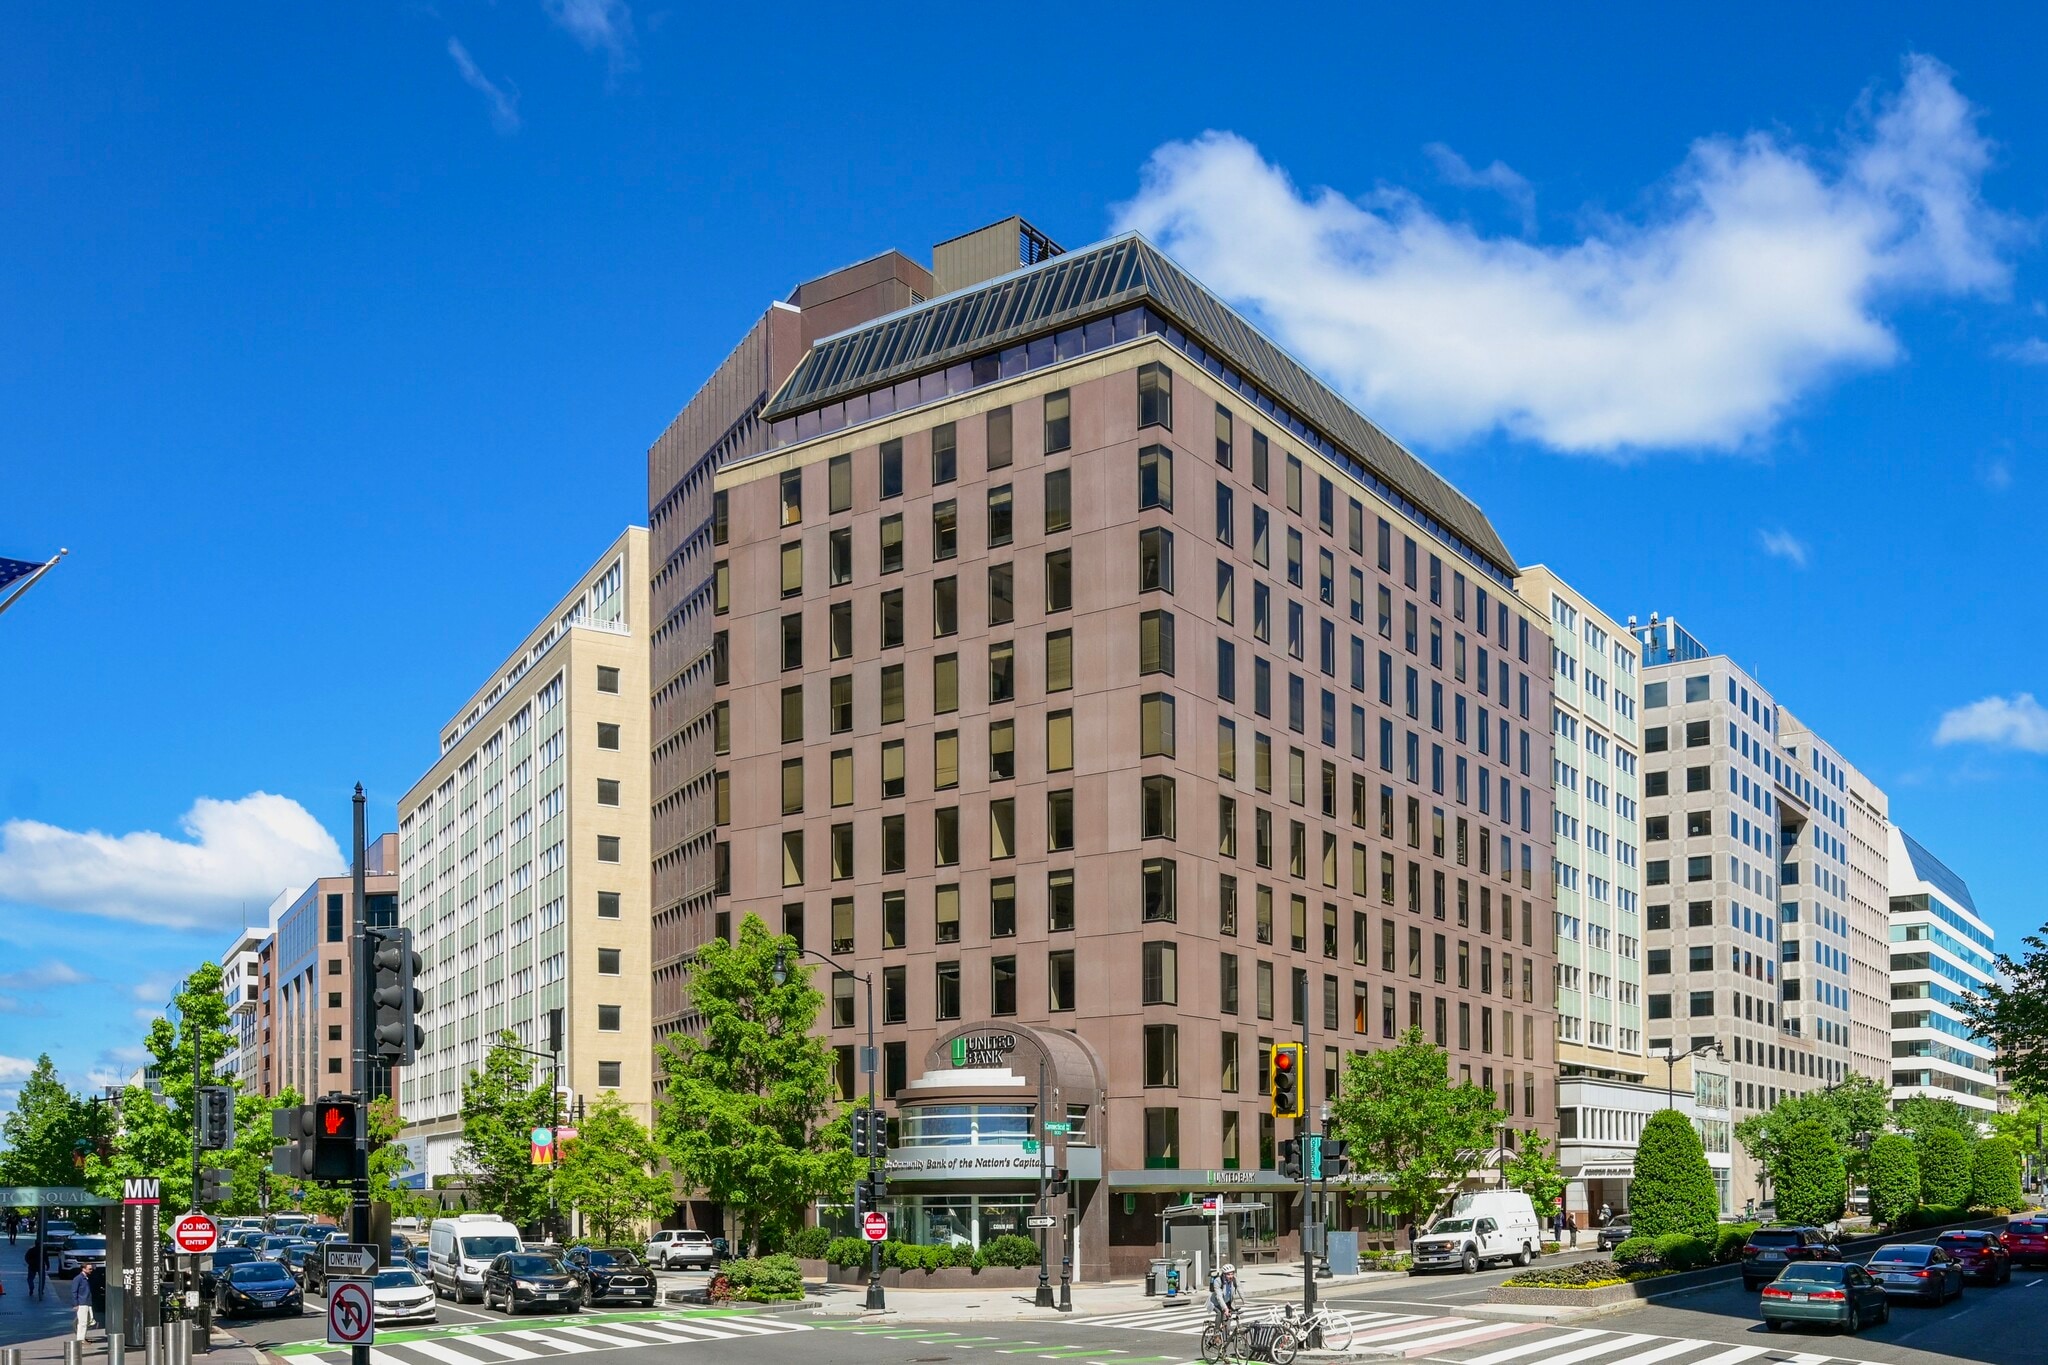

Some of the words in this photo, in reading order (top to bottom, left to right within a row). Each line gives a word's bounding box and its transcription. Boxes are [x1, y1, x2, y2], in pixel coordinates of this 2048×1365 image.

[968, 1034, 1017, 1050] UNITED
[967, 1049, 1004, 1065] BANK
[926, 1158, 947, 1170] Bank
[948, 1157, 958, 1170] of
[959, 1157, 973, 1168] the
[974, 1157, 1011, 1168] Nation's
[1013, 1157, 1042, 1170] Capita
[1215, 1172, 1239, 1184] UNITED
[40, 1191, 93, 1204] SQUAR
[134, 1204, 143, 1239] Farragut
[152, 1204, 160, 1238] Farragut
[135, 1241, 143, 1265] North
[330, 1253, 345, 1266] ONE
[347, 1253, 362, 1266] WAY
[135, 1266, 143, 1297] Station
